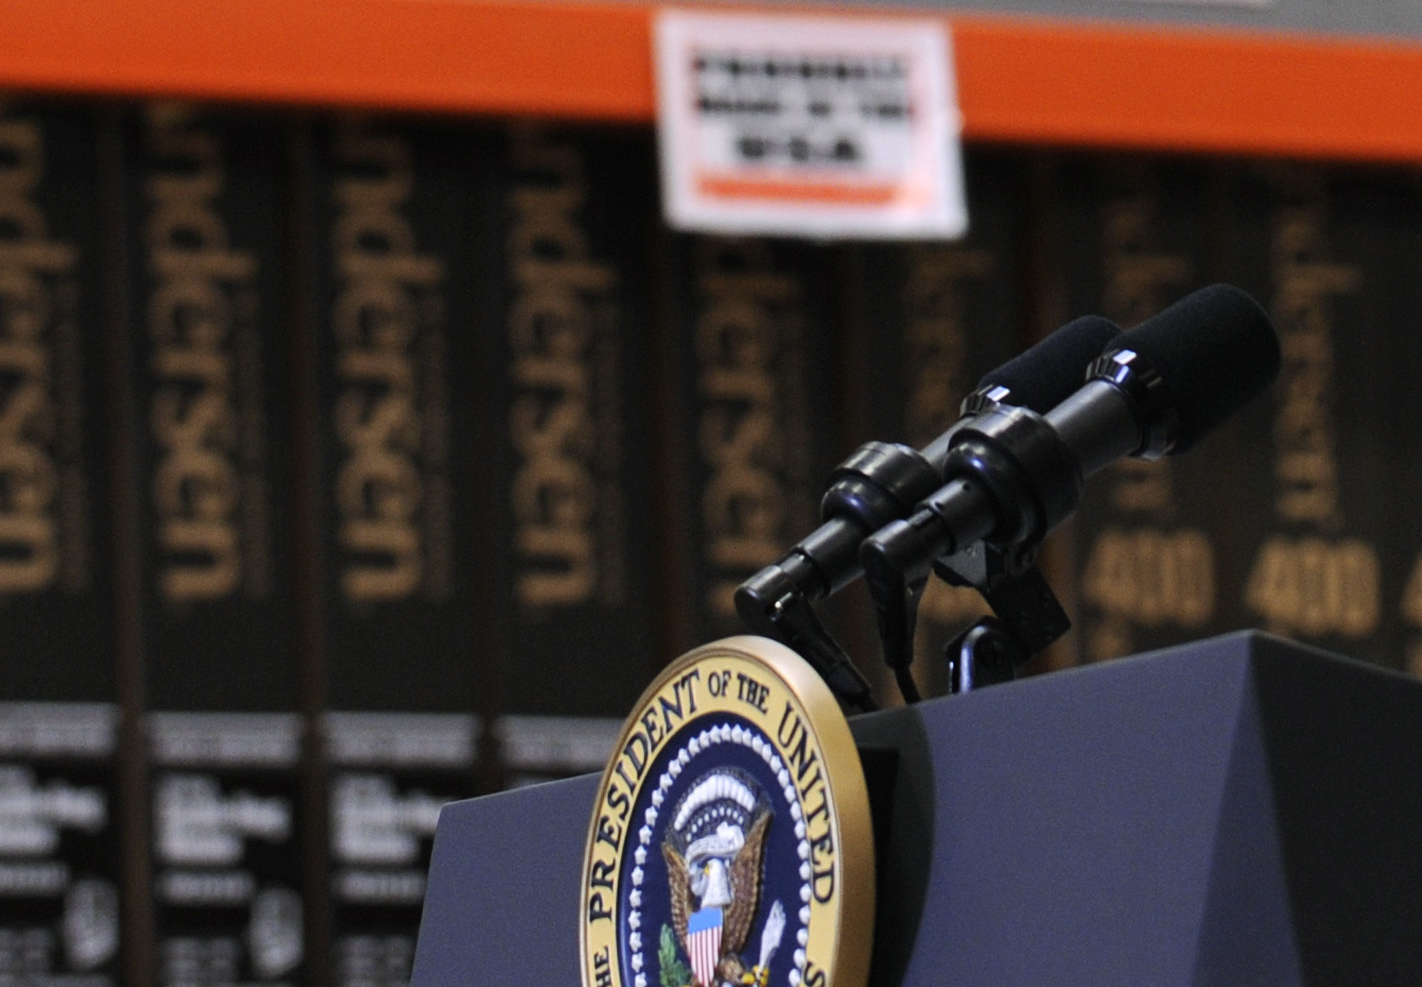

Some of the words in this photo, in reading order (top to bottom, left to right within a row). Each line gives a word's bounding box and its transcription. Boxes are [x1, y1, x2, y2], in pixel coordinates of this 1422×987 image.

[330, 113, 446, 603] ndersen
[507, 123, 620, 606] ndersen
[1246, 535, 1381, 639] 400
[708, 670, 731, 698] OF
[737, 674, 770, 714] THE
[589, 669, 700, 924] PRESIDENT
[777, 701, 835, 905] UNITED
[594, 945, 613, 987] HE
